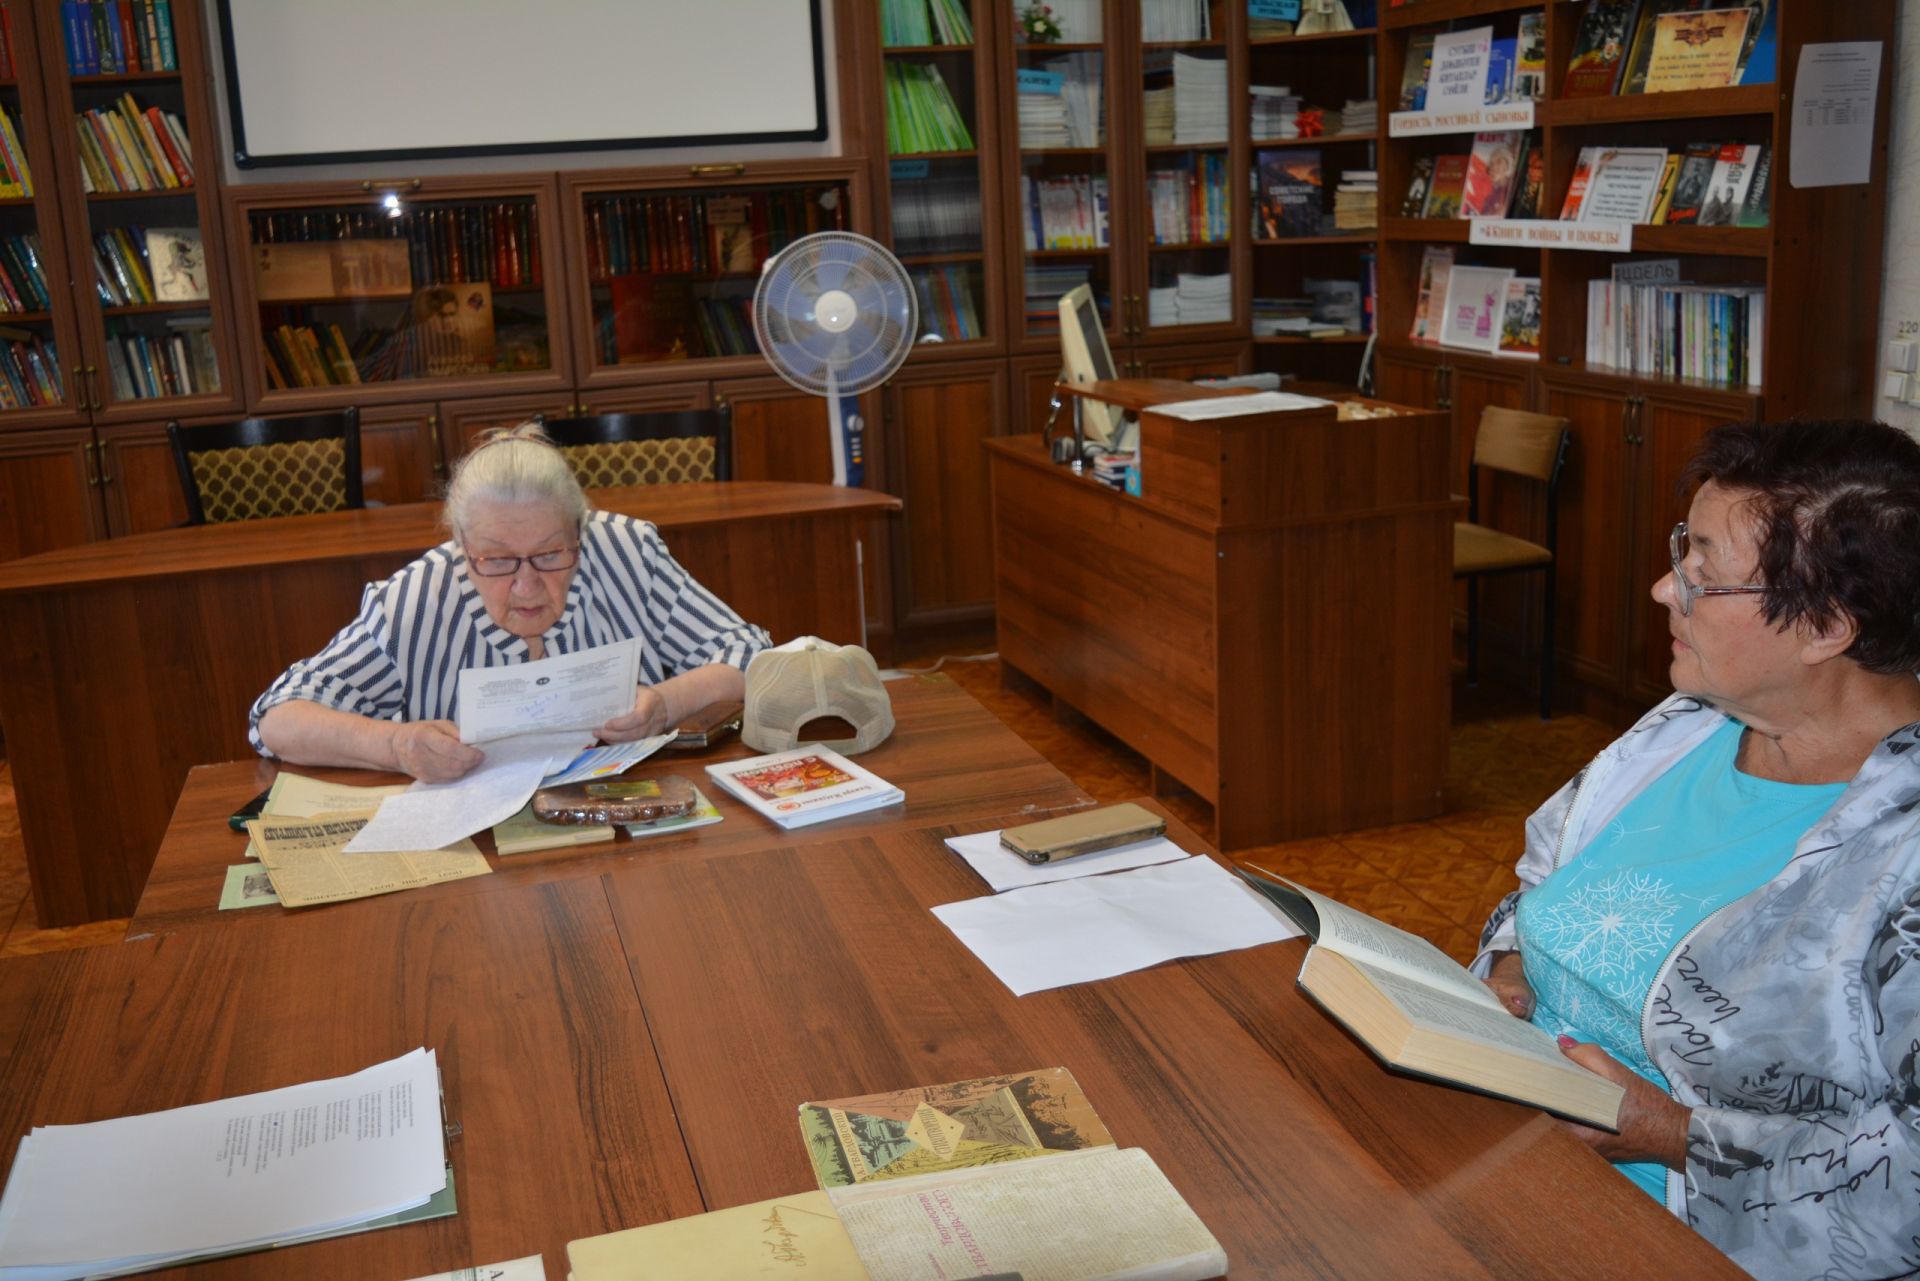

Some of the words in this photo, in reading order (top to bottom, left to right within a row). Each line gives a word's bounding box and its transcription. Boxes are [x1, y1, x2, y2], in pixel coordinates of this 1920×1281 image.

[1393, 116, 1433, 131] ГОРДОСТЬ
[1485, 110, 1529, 125] СЫНОВЬЯ
[1528, 225, 1562, 241] ВОЙНЫ
[1899, 320, 1919, 334] 220
[1742, 1199, 1777, 1223] is
